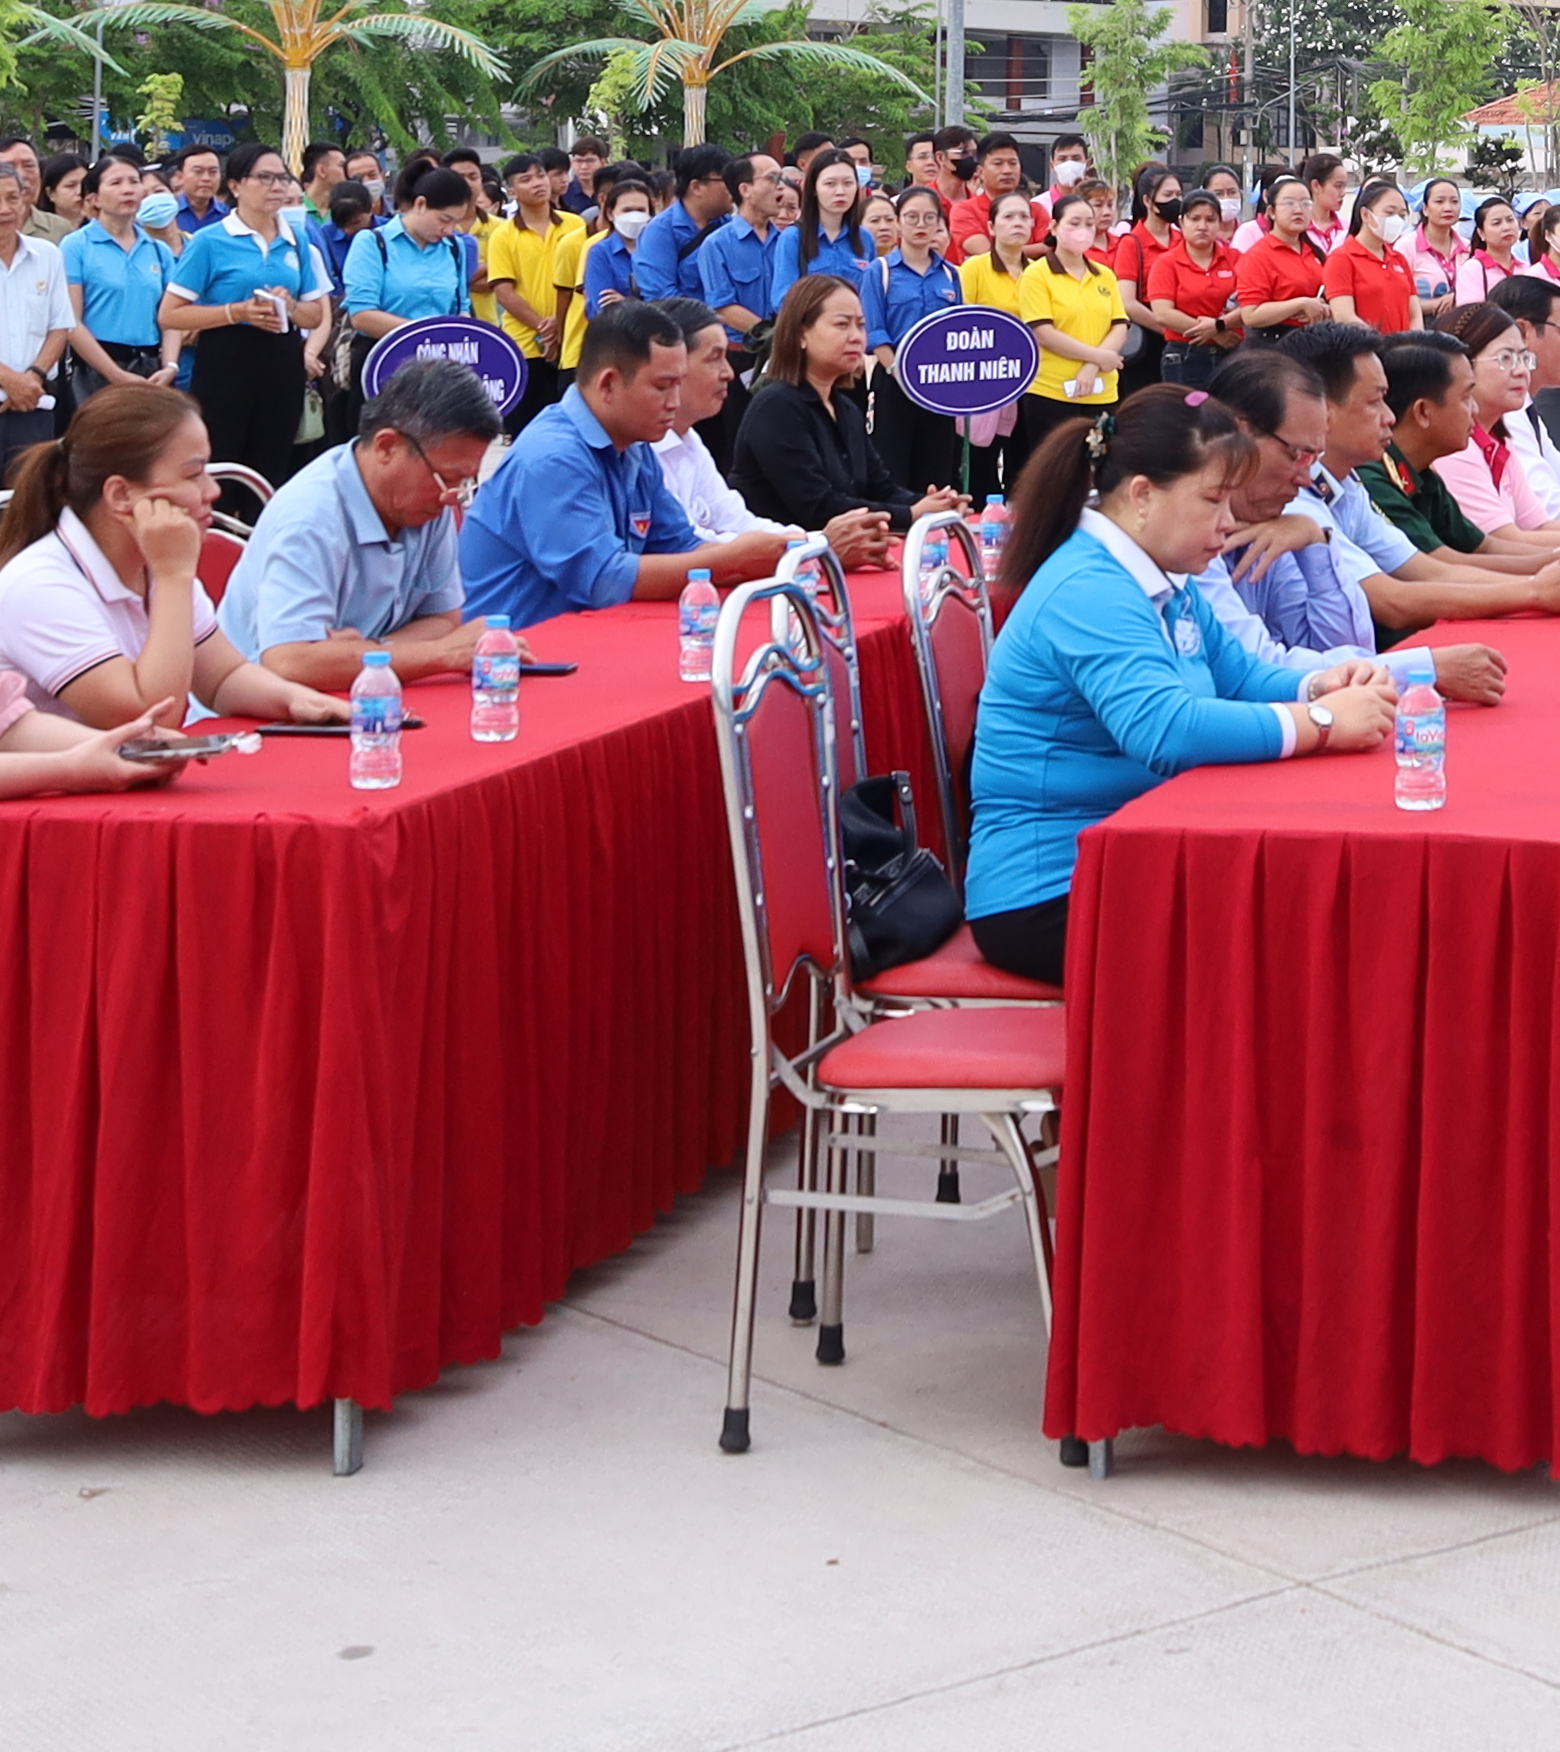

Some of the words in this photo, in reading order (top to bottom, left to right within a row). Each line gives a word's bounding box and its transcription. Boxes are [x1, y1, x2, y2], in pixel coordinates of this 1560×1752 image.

[192, 130, 236, 148] vinap
[416, 338, 446, 361] CÔNG
[448, 336, 479, 364] NHÂN
[946, 325, 994, 351] ĐOÀN
[918, 361, 975, 384] THANH
[979, 356, 1020, 380] NIÊN
